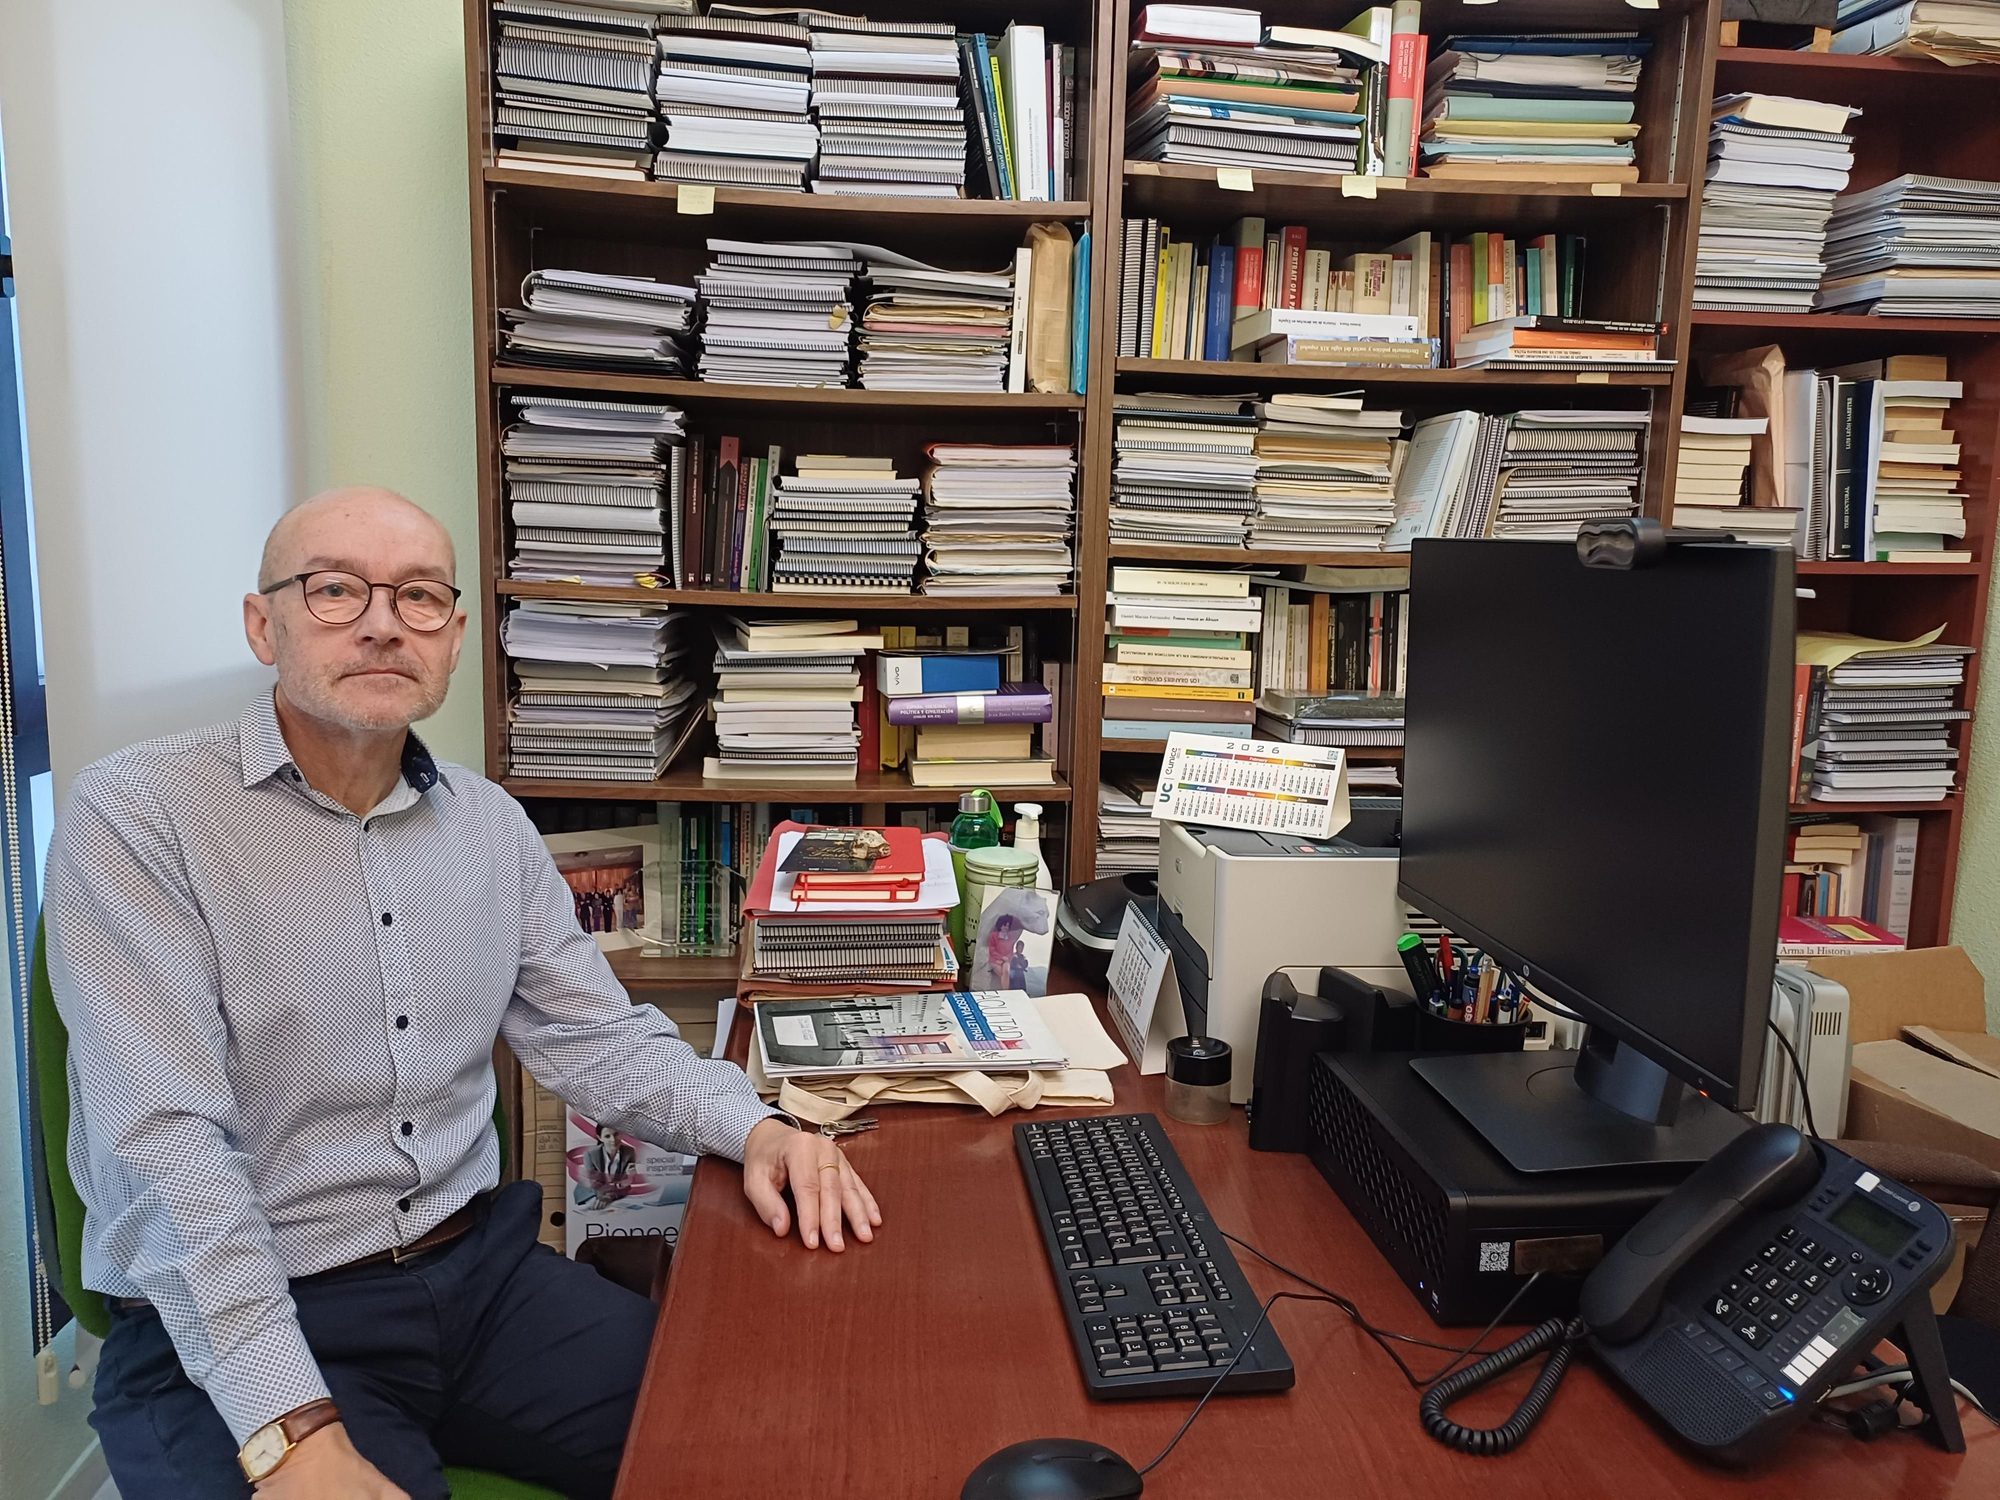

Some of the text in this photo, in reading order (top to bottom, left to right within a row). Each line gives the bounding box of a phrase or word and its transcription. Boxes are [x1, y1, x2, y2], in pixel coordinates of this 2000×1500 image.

[1290, 247, 1300, 281] PORTRAIT
[1290, 283, 1298, 293] OF
[1504, 276, 1512, 315] ESPAÑOLA
[1226, 742, 1280, 754] 2026
[1158, 782, 1173, 803] UC
[1780, 946, 1851, 955] Arma la Historia
[966, 1020, 986, 1041] LETRAS
[646, 1155, 676, 1165] special
